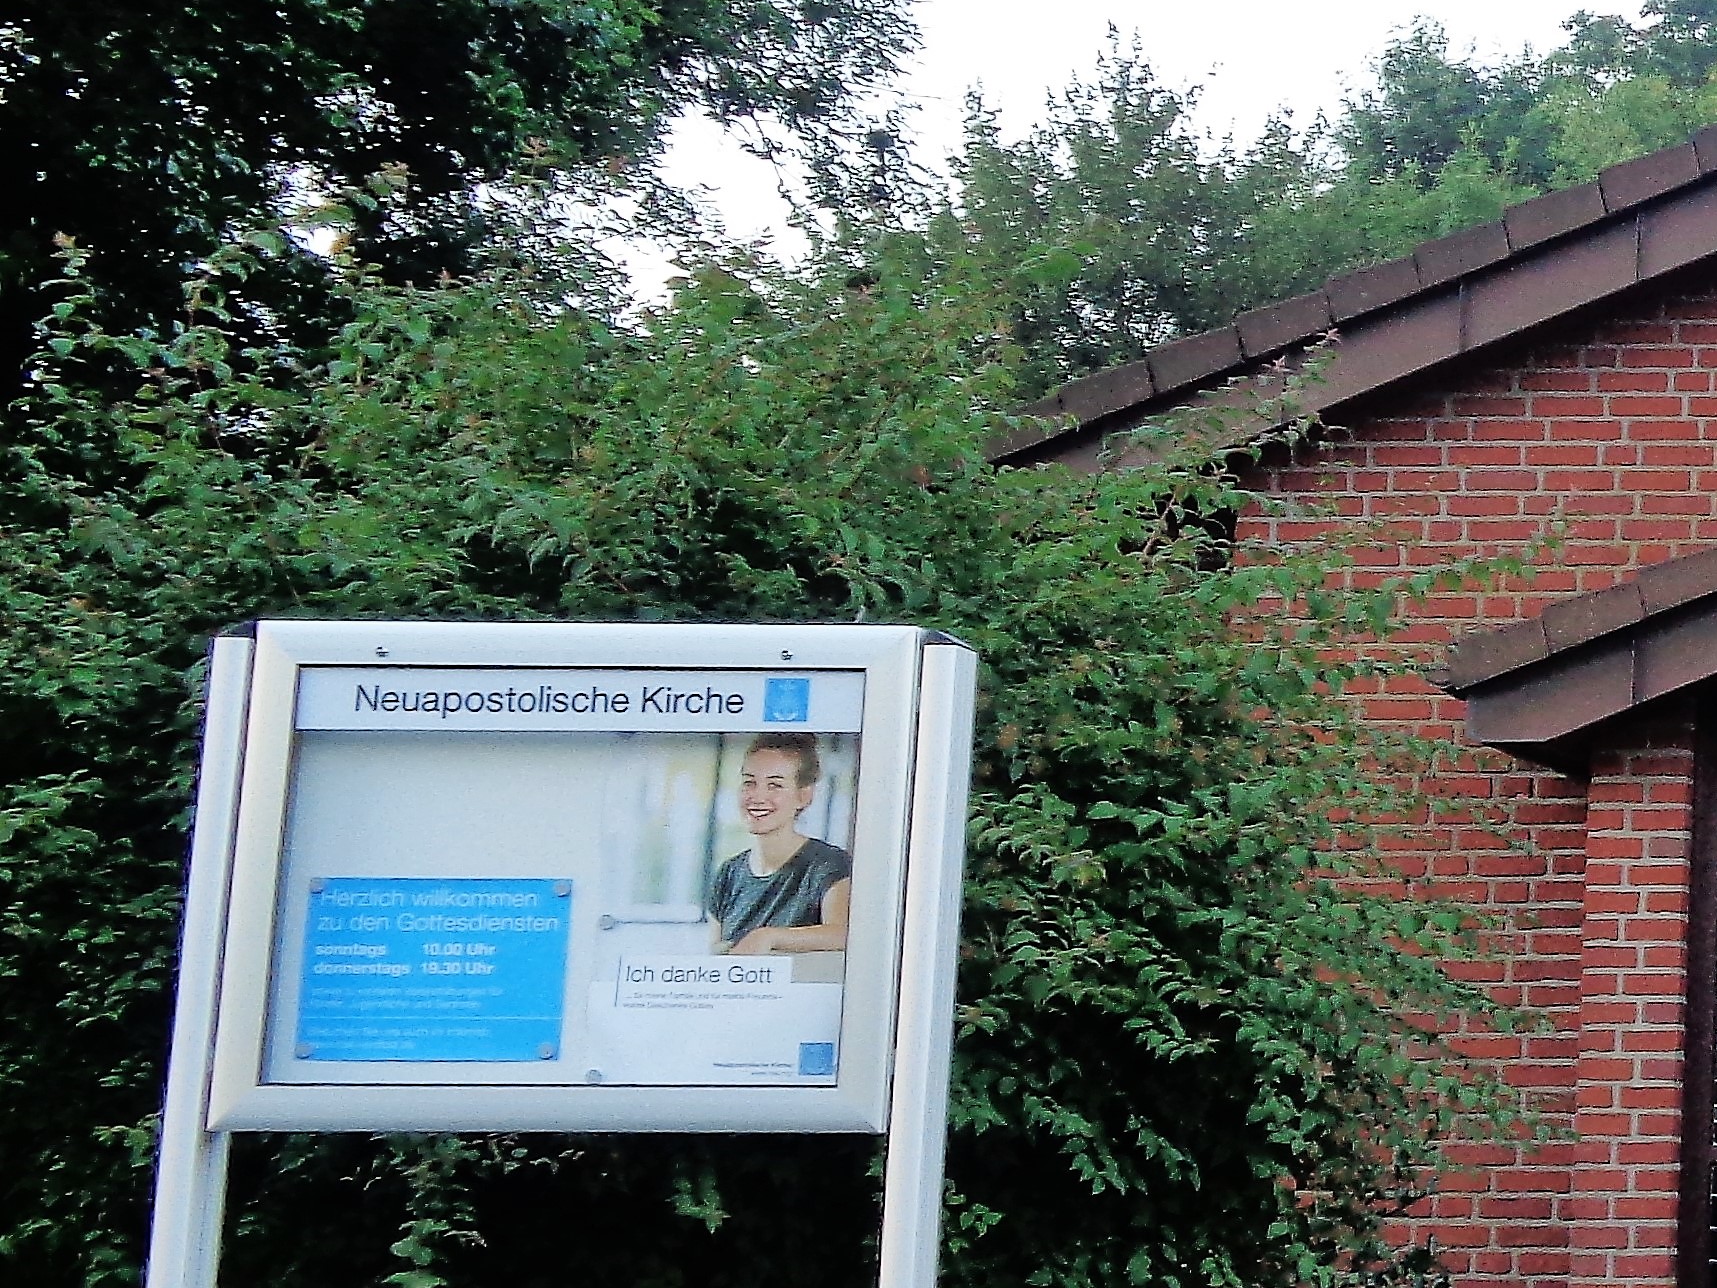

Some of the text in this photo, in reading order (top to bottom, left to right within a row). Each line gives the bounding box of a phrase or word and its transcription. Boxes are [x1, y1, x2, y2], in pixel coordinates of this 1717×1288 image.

[354, 684, 745, 719] Neuapostolische Kirche
[320, 888, 538, 908] Herzlich willkommen
[317, 912, 559, 932] zu den Gottesdiensten
[315, 943, 387, 957] sonntags
[466, 942, 496, 956] Uhr
[313, 961, 411, 978] donnerstags
[465, 962, 495, 975] Uhr
[625, 965, 773, 983] Ich danke Gott
